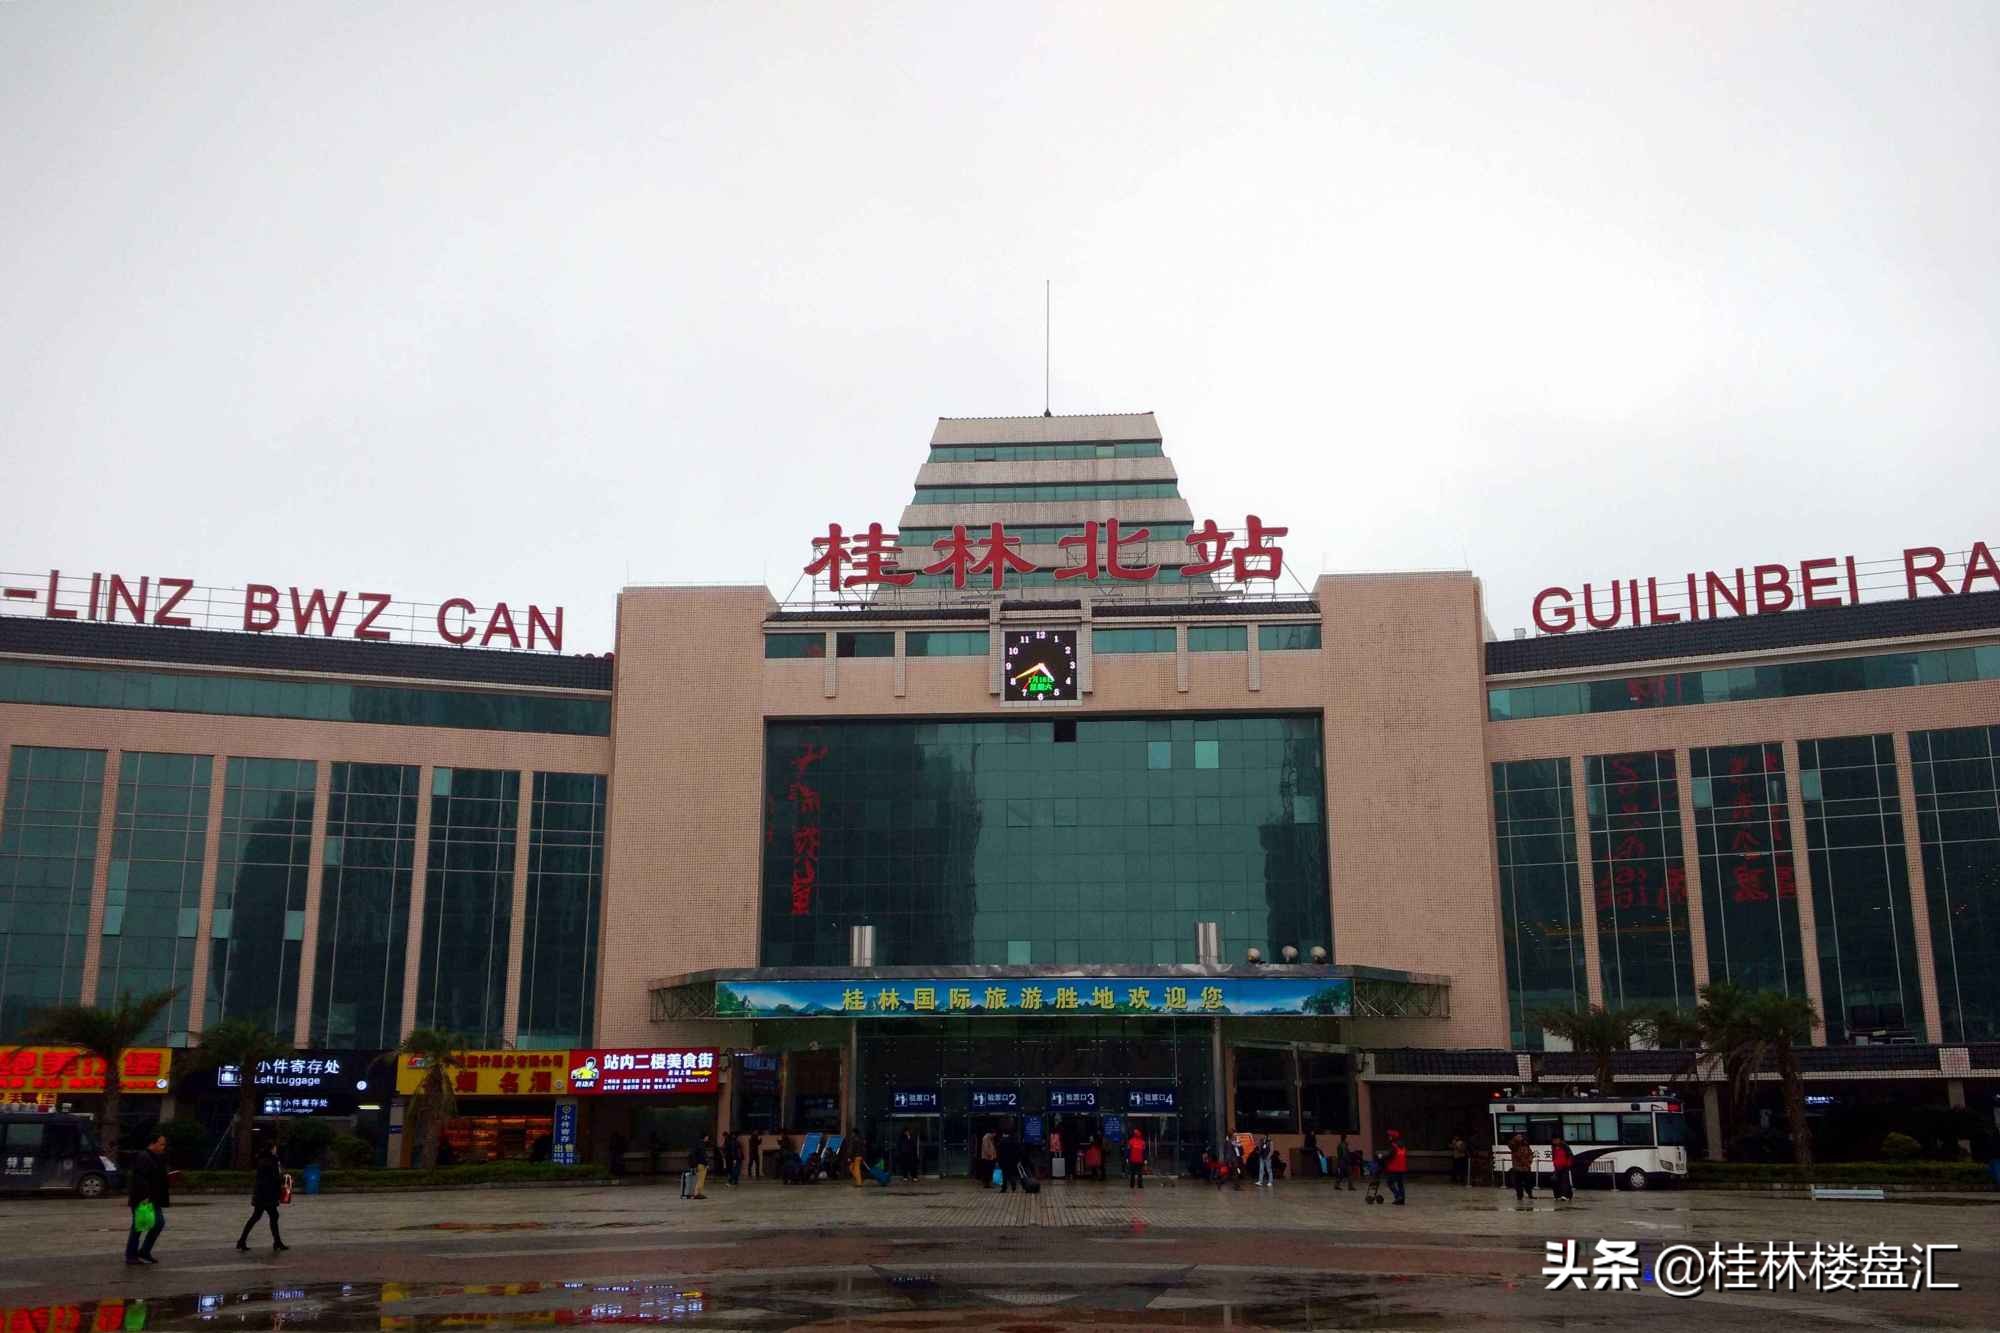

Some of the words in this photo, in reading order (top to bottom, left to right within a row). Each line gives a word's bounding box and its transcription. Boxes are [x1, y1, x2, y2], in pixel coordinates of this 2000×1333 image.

[803, 514, 1288, 592] 桂林北站
[1532, 555, 1860, 635] GUILINBEI
[243, 583, 392, 641] BWZ
[436, 598, 564, 651] CAN
[1020, 635, 1030, 644] 11
[1036, 631, 1046, 639] 12
[1054, 635, 1059, 643] 1
[1008, 647, 1019, 655] 10
[1064, 646, 1071, 655] 2
[1005, 662, 1012, 670] 9
[1069, 661, 1076, 669] 3
[1065, 677, 1072, 685] 4
[1021, 688, 1028, 697] 7
[842, 986, 1224, 1011] 桂林国际旅游胜地欢迎您
[604, 1053, 713, 1070] 站内二楼美食街
[256, 1059, 340, 1074] 小件寄存处
[254, 1075, 274, 1084] Left
[276, 1075, 321, 1087] Luggage
